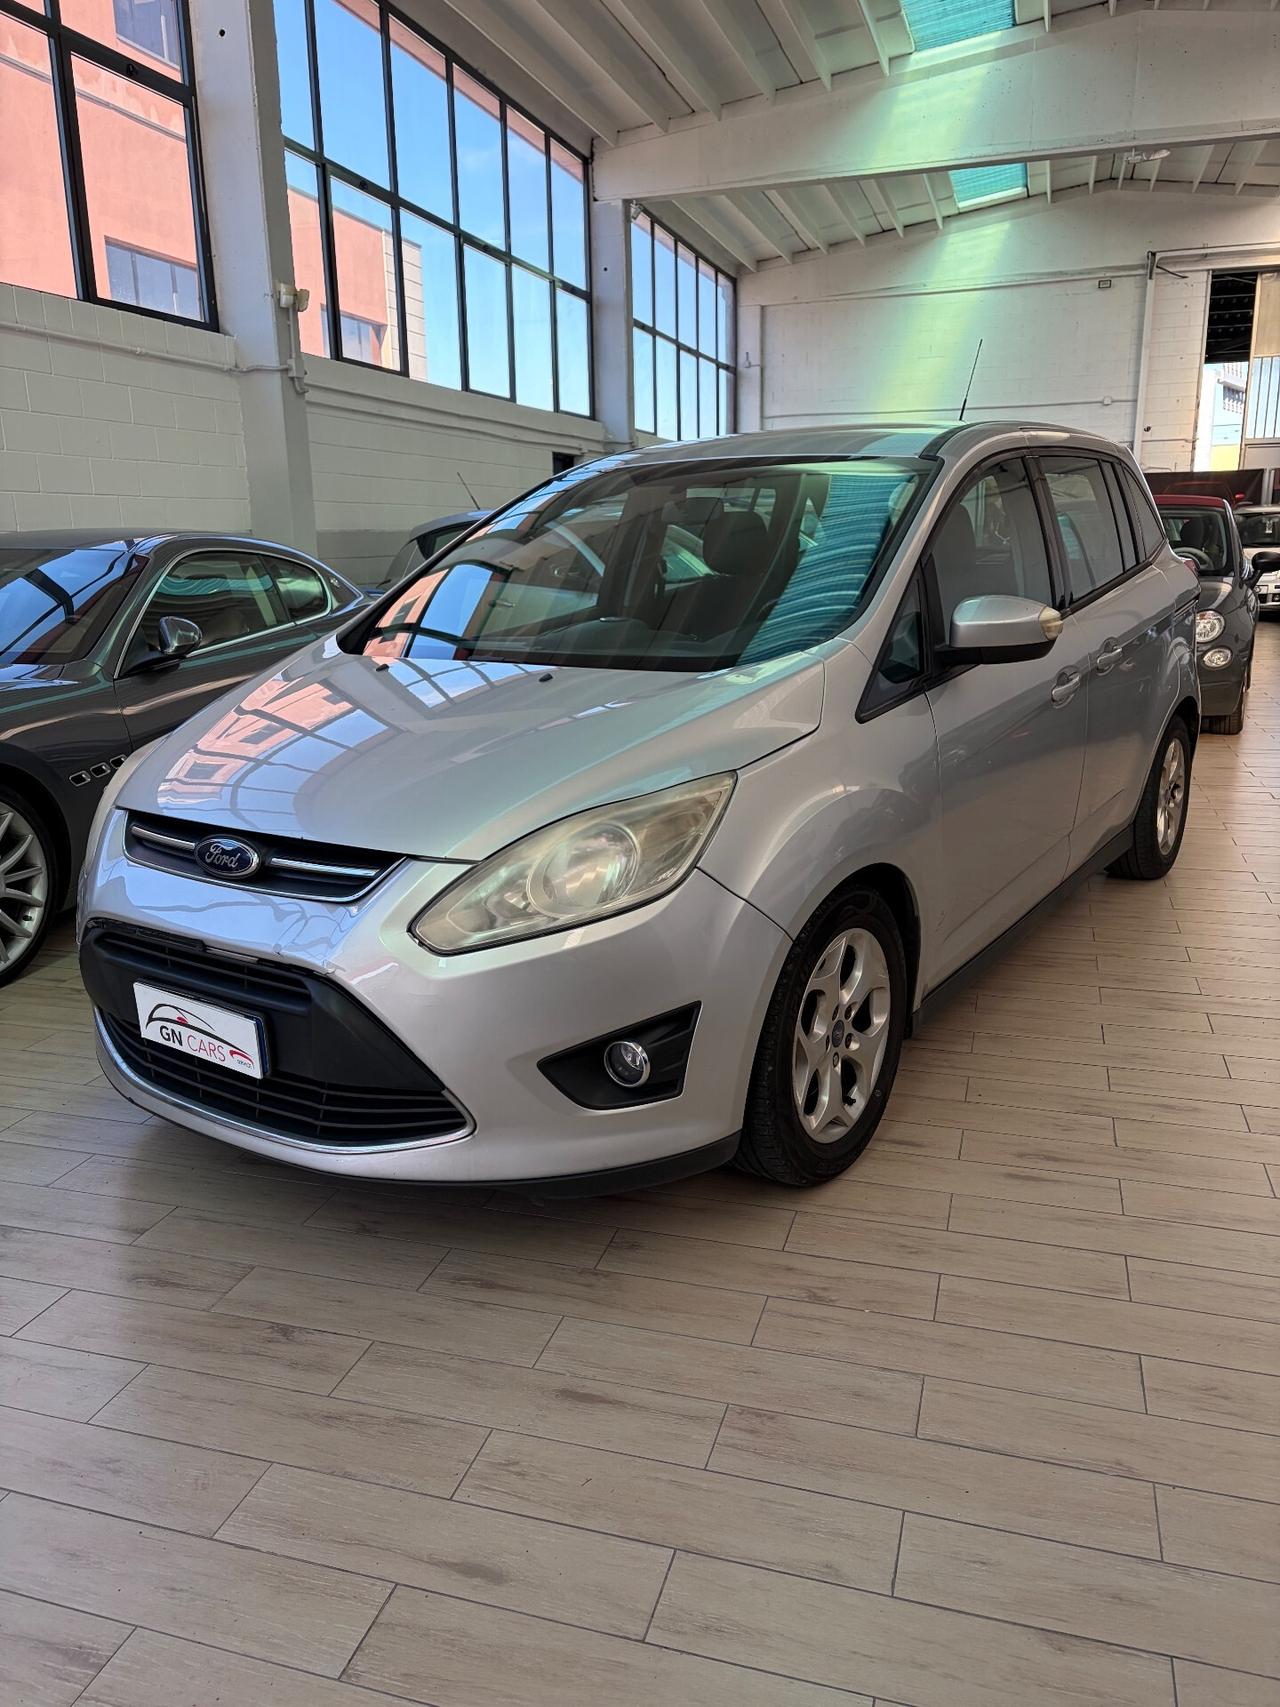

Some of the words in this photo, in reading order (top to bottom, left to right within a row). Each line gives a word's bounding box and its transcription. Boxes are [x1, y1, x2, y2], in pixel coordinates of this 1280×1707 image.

[205, 843, 241, 868] Ford
[159, 1025, 183, 1047] GN
[186, 1034, 226, 1062] CARS
